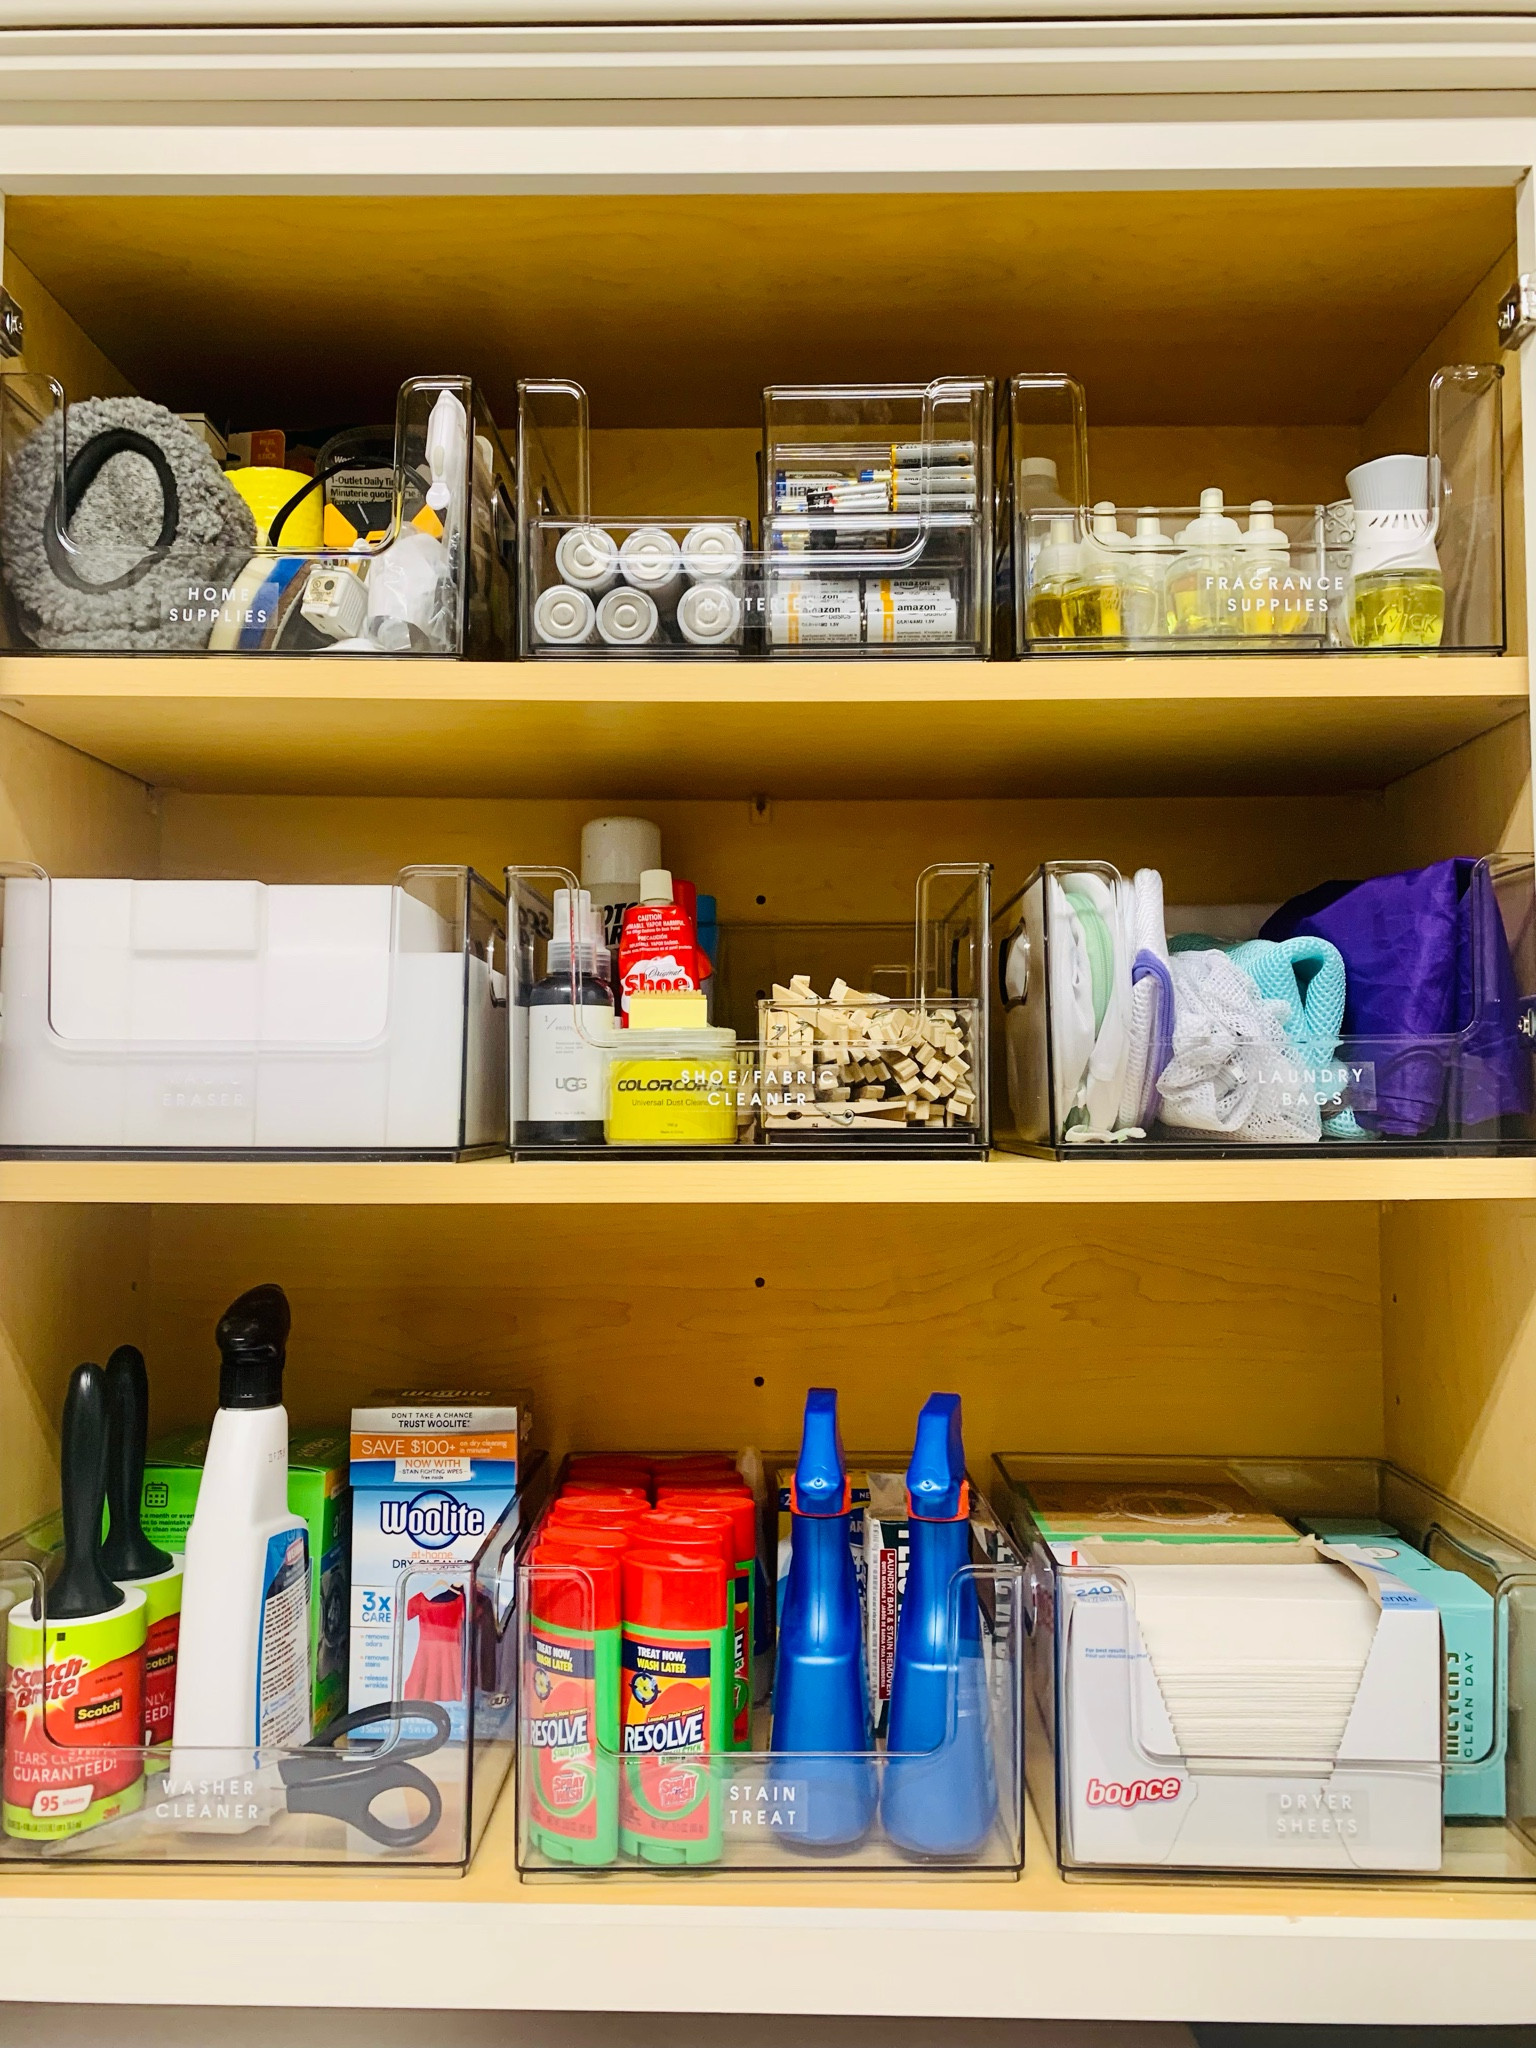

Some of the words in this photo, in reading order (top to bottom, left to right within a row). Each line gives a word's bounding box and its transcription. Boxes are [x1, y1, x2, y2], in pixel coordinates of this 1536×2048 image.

[331, 476, 362, 485] 1-Outlet
[364, 477, 384, 487] Daily
[330, 488, 369, 497] Minuterie
[1206, 576, 1344, 591] FRAGRANCE
[188, 587, 250, 601] HOME
[1228, 598, 1329, 612] SUPPLIES
[169, 608, 267, 623] SUPPLIES
[637, 914, 662, 922] CAUTION
[648, 966, 682, 978] Original
[624, 973, 690, 996] Shoe
[555, 1076, 588, 1092] UGG
[680, 1070, 834, 1085] SHOE/FABRIC
[1258, 1068, 1363, 1084] LAUNDRY
[162, 1093, 244, 1107] ERASER
[632, 1098, 664, 1106] Universal
[666, 1098, 684, 1106] Dust
[685, 1098, 710, 1106] Cleane
[707, 1092, 807, 1107] CLEANER
[1282, 1091, 1343, 1106] BAGS
[444, 1411, 473, 1419] CHANCE
[399, 1420, 425, 1428] TRUST
[361, 1439, 405, 1455] SAVE
[410, 1439, 456, 1456] $100+
[469, 1439, 481, 1448] dry
[405, 1459, 431, 1468] NOW
[433, 1459, 461, 1468] WITH
[380, 1501, 484, 1536] Woolite
[411, 1551, 454, 1559] at-home
[392, 1560, 414, 1569] DRY
[886, 1552, 895, 1595] LAUNDRY
[1075, 1585, 1113, 1597] 240
[1381, 1595, 1417, 1603] entle
[362, 1591, 391, 1612] 3x
[886, 1596, 894, 1615] BAR
[362, 1612, 391, 1623] CARE
[886, 1625, 894, 1650] STAIN
[552, 1645, 573, 1663] NOW,
[637, 1646, 660, 1660] TREAT
[661, 1648, 686, 1663] NOW,
[146, 1654, 174, 1671] cotch
[552, 1659, 573, 1673] LATER
[637, 1658, 660, 1672] WASH
[661, 1661, 687, 1674] LATER
[1464, 1651, 1475, 1687] DAY
[77, 1700, 121, 1720] Scotch
[647, 1714, 667, 1722] Laundry
[682, 1705, 704, 1716] Remover
[530, 1714, 588, 1748] RESOLVE
[623, 1713, 705, 1753] RESOLVE
[1464, 1697, 1474, 1758] CLEAN
[14, 1750, 48, 1766] TEARS
[13, 1758, 118, 1783] GUARANTEED!
[162, 1780, 254, 1795] WASHER
[730, 1785, 796, 1802] STAIN
[1087, 1777, 1181, 1809] bounce
[39, 1795, 59, 1812] 95
[1280, 1794, 1352, 1810] DRYER
[155, 1803, 258, 1819] CLEANER
[730, 1810, 796, 1825] TREAT
[1277, 1818, 1358, 1834] SHEETS
